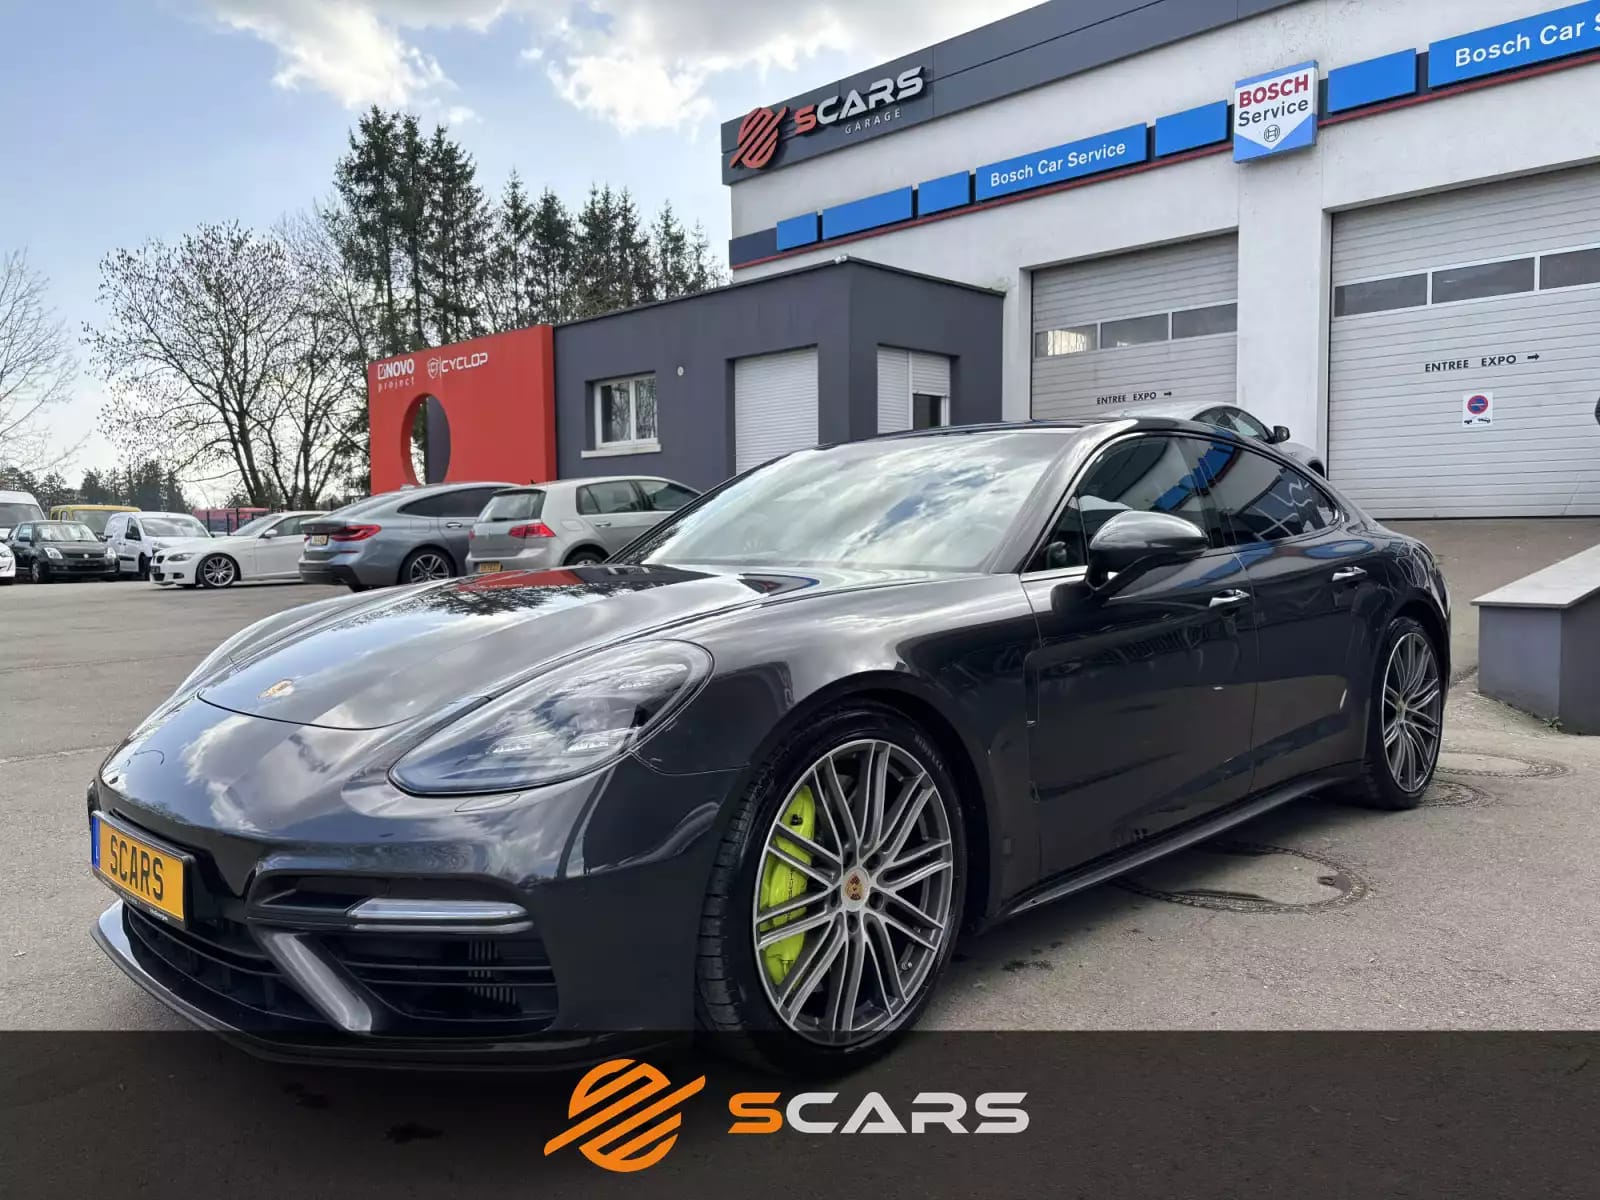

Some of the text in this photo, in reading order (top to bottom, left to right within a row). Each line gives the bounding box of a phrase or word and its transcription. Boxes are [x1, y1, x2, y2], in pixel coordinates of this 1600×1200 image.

[1455, 34, 1530, 67] Bosch
[1540, 20, 1585, 45] Car
[794, 65, 924, 135] SCARS
[1239, 73, 1309, 108] BOSCH
[844, 108, 901, 134] GARAGE
[1238, 99, 1309, 127] Service
[990, 142, 1126, 187] Bosch Car Service
[441, 352, 489, 373] CYCLOP
[1424, 354, 1517, 373] ENTREE EXPO
[1096, 391, 1157, 405] ENTREE EXPO
[110, 834, 165, 902] SCARS
